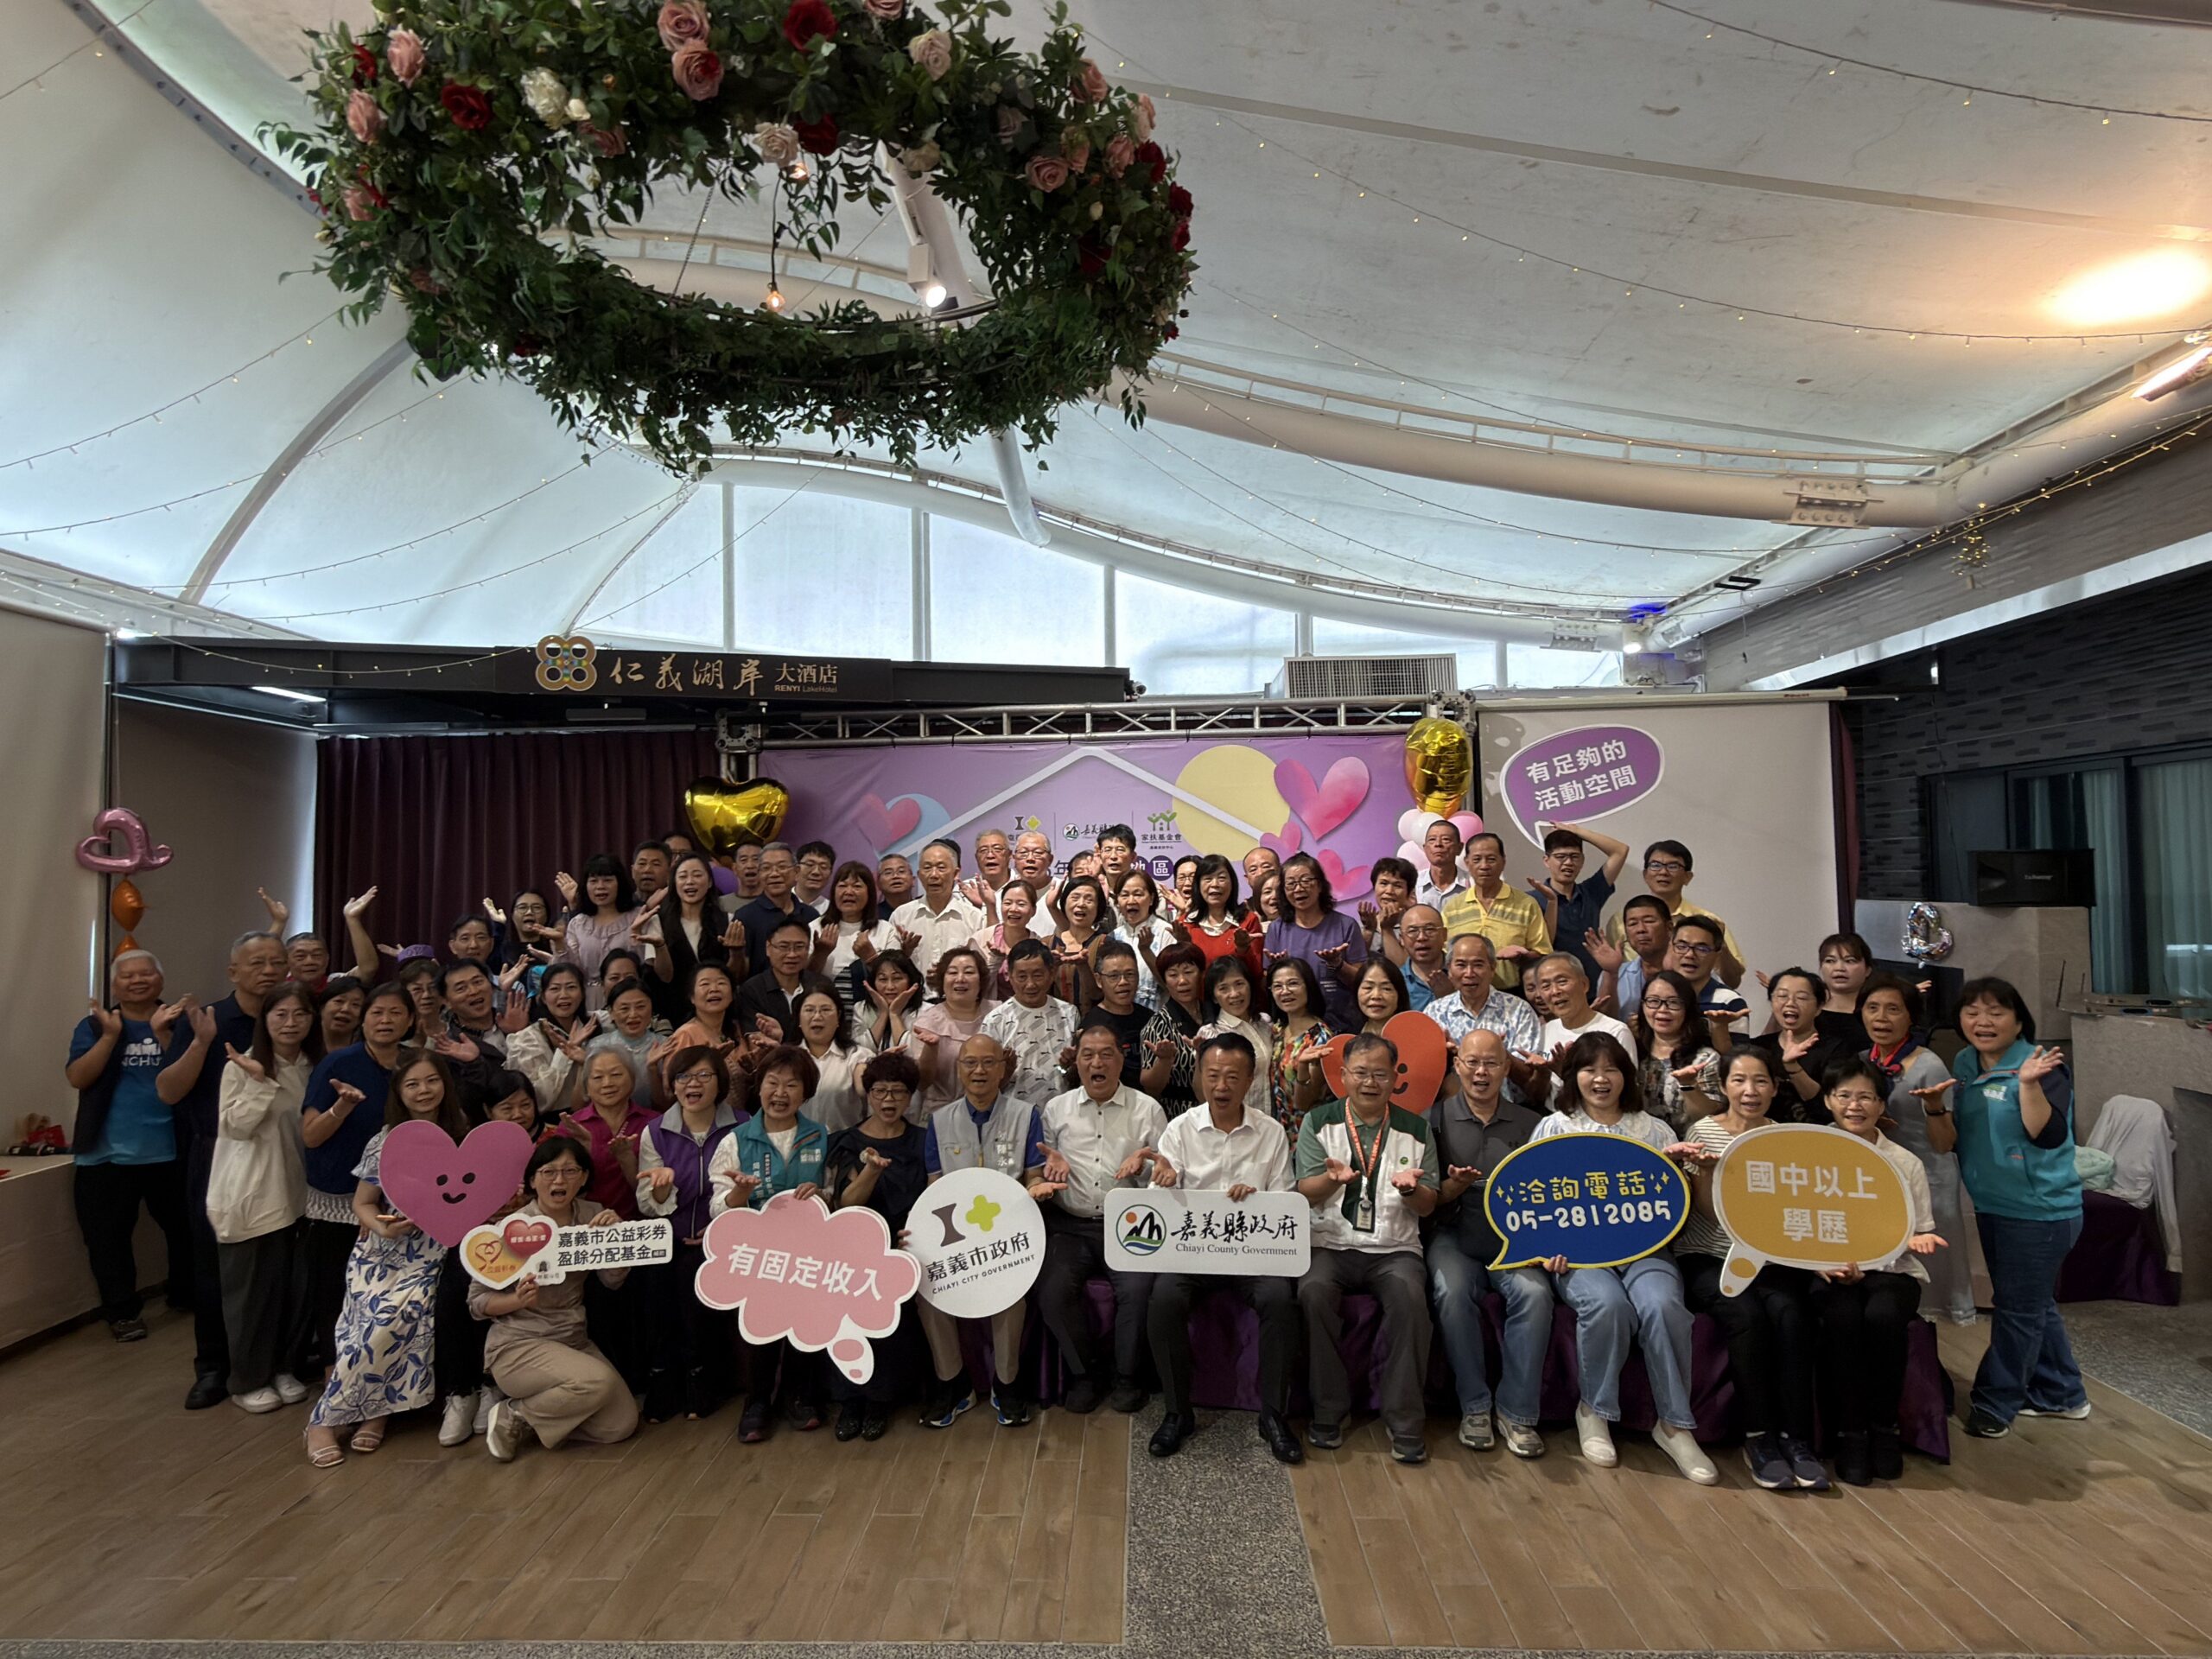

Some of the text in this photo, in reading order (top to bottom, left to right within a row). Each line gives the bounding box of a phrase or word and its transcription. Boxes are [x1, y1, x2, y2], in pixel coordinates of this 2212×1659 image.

[609, 653, 839, 696] 仁義湖岸 大酒店
[1526, 740, 1627, 784] 有足夠的
[1535, 766, 1637, 810] 活動空間
[1519, 1169, 1647, 1205] 洽詢電話
[1746, 1160, 1878, 1200] 國中以上
[1171, 1210, 1299, 1243] 嘉義縣政府
[1505, 1198, 1672, 1232] 05-2812085
[1783, 1207, 1849, 1245] 學歷
[557, 1244, 652, 1267] 盈餘分配基金
[558, 1224, 668, 1249] 嘉義市公益彩券
[1175, 1243, 1298, 1255] Chiayi County Government
[728, 1243, 883, 1301] 有固定收入
[925, 1230, 1031, 1282] 嘉義市政府
[931, 1255, 1036, 1294] CHIAYI CITY GOVERNMENT
